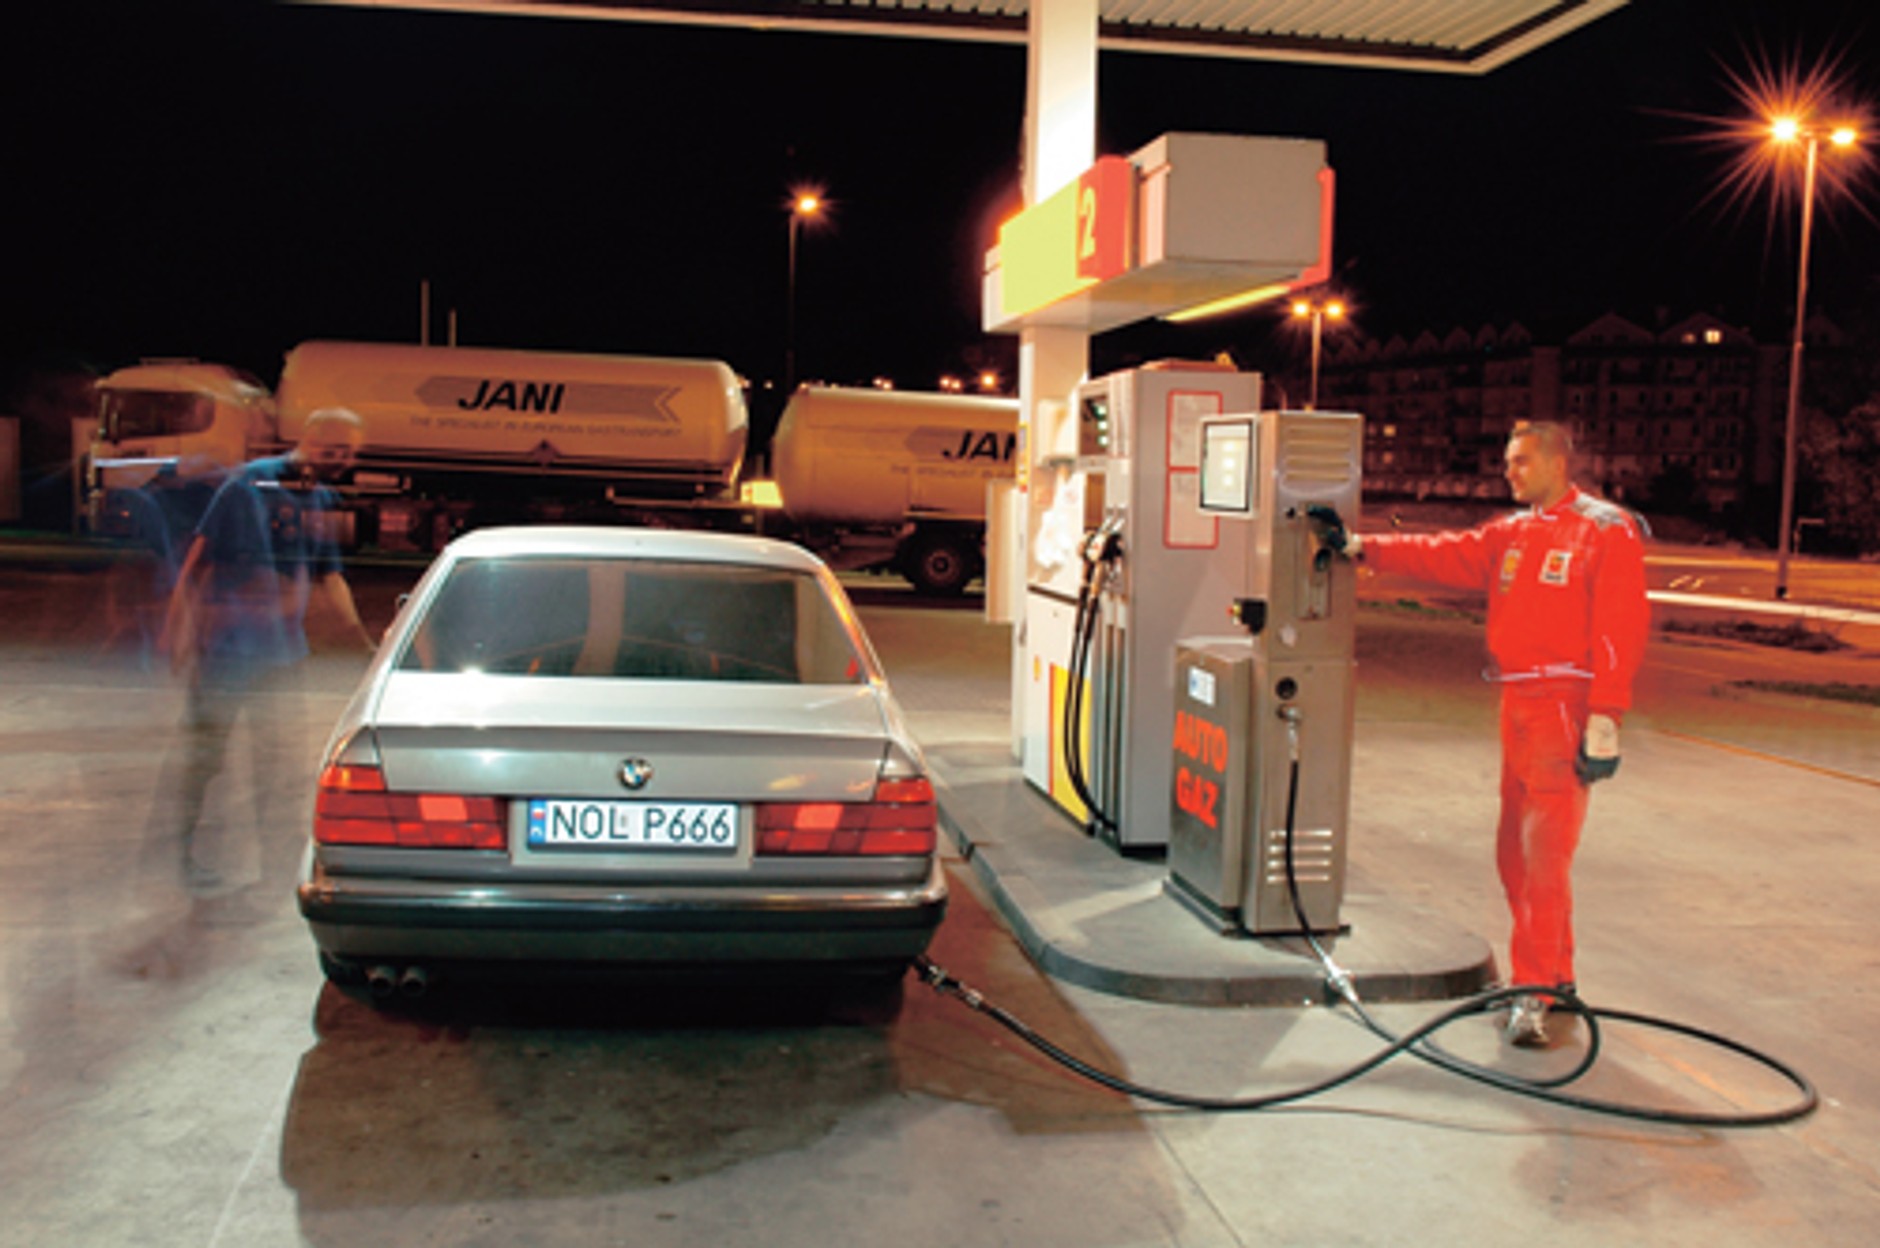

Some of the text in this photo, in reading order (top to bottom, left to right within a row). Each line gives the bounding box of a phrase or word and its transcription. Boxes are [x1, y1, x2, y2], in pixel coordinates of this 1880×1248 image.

[1080, 186, 1096, 258] 2
[457, 379, 565, 415] JANI
[1173, 710, 1228, 773] AUTO
[552, 804, 731, 843] NOL P666
[1176, 767, 1218, 828] GAZ
